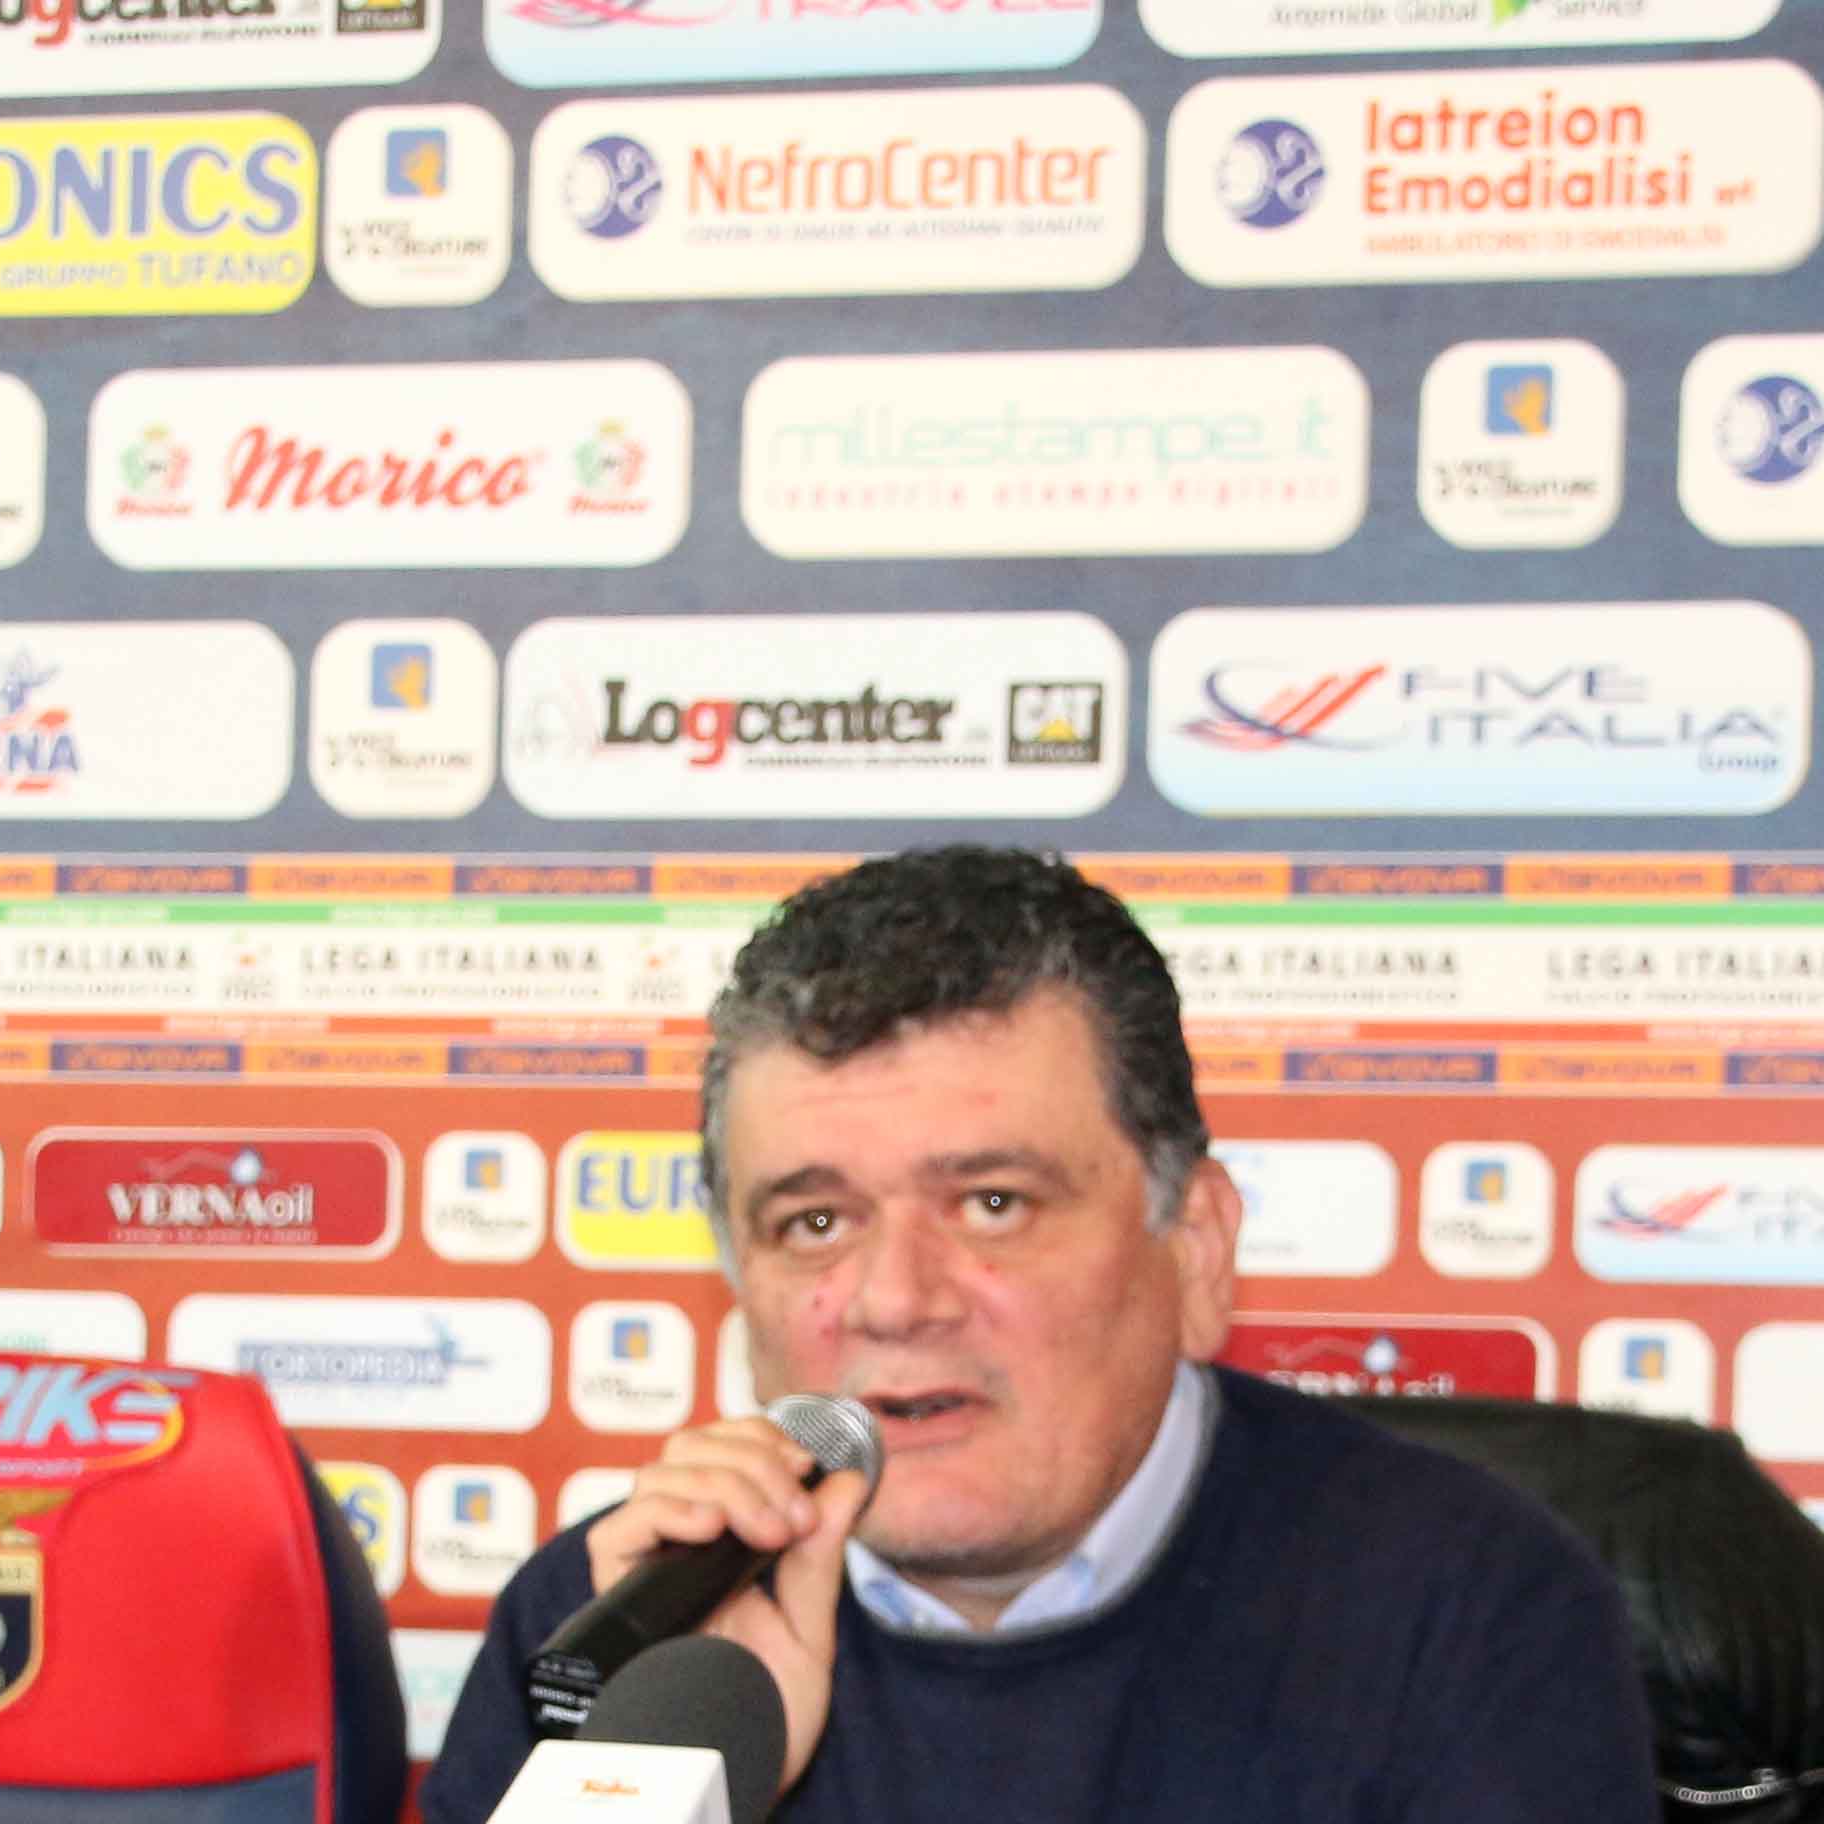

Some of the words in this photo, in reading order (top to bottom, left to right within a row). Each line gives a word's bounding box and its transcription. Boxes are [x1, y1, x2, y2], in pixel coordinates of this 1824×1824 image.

[1365, 90, 1646, 154] Iatreion
[687, 133, 1116, 217] NefroCenter
[1363, 152, 1694, 216] Emodialisi
[136, 251, 306, 288] TUFANO
[222, 424, 530, 512] Morico
[1400, 664, 1648, 702] FIVE
[603, 680, 957, 765] Logcenter
[1426, 711, 1780, 747] ITALIA
[16, 945, 195, 972] ITALIANA
[303, 945, 400, 973] LEGA
[416, 945, 602, 973] ITALIANA
[1260, 947, 1460, 977] ITALIANA
[1546, 948, 1656, 977] LEGA
[106, 1183, 314, 1227] VERNAoil
